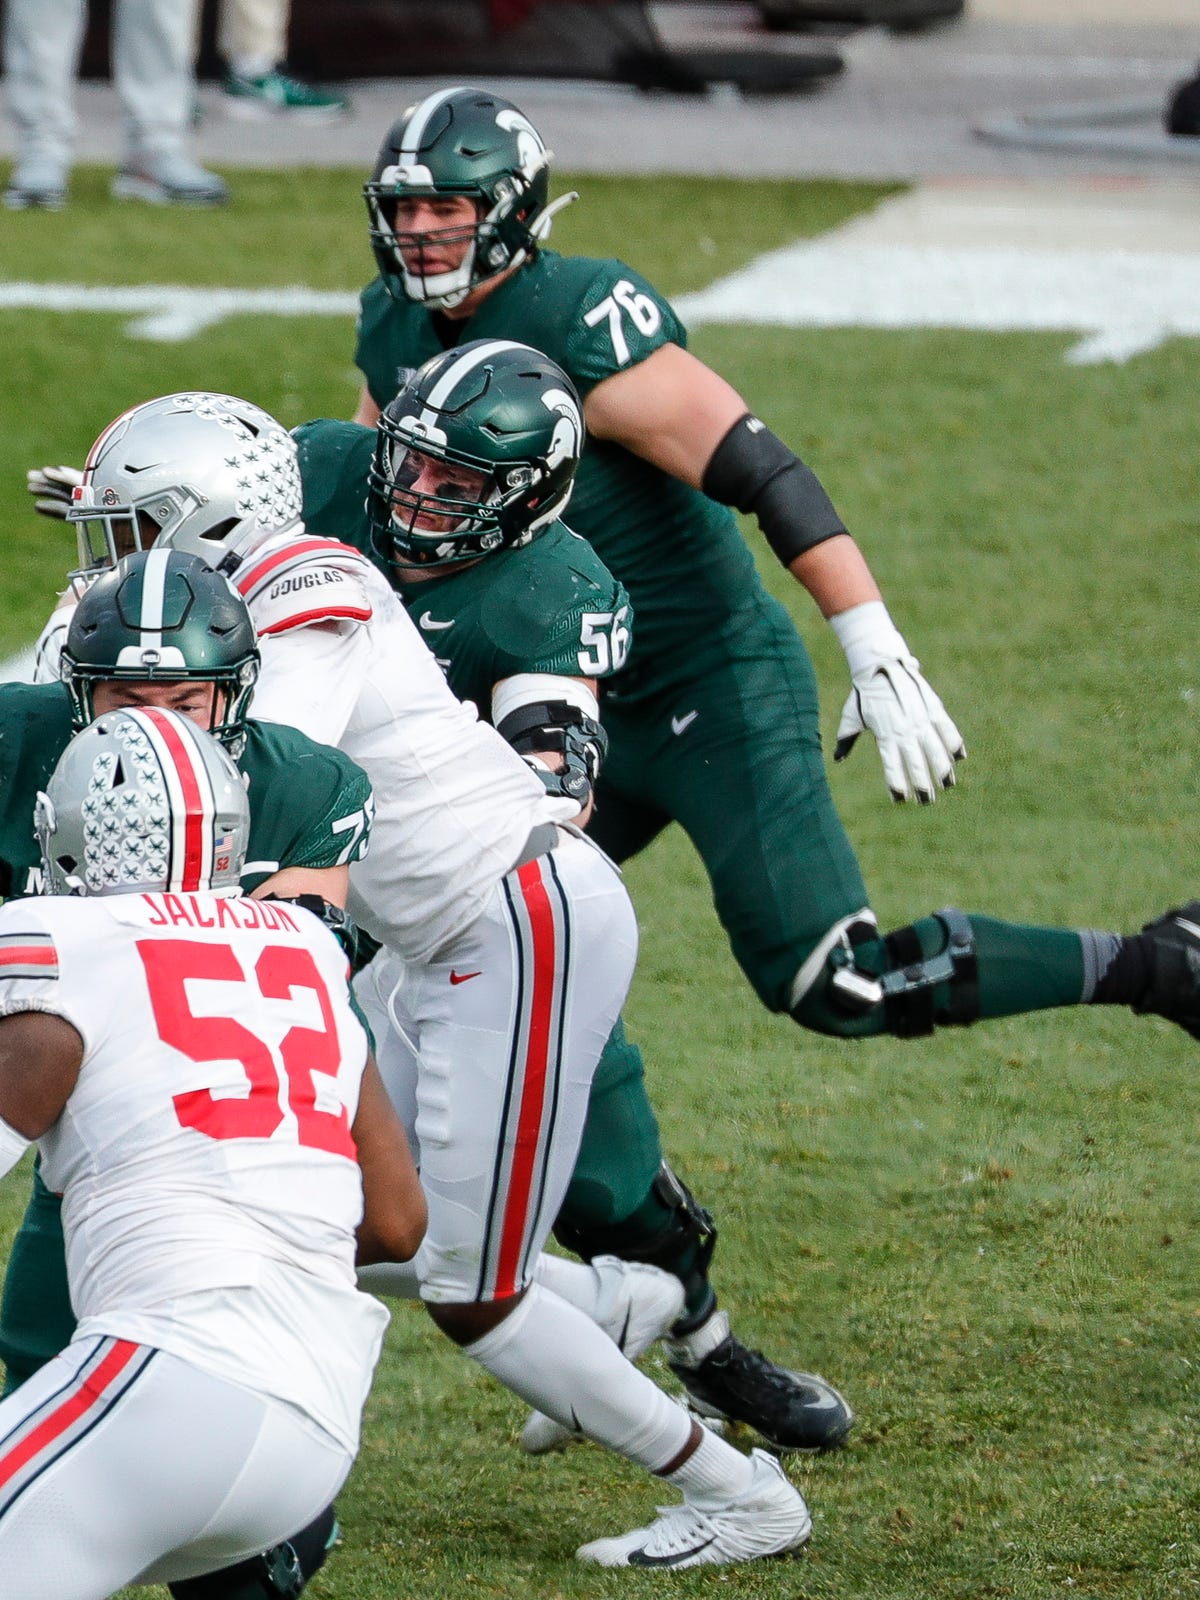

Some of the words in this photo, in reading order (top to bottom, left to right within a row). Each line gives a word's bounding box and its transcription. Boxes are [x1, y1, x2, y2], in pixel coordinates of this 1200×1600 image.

[583, 279, 663, 366] 76
[270, 570, 344, 601] DOUGLAS
[577, 605, 630, 675] 56
[216, 855, 230, 871] 52
[140, 892, 302, 933] JACKSON
[135, 938, 358, 1162] 52
